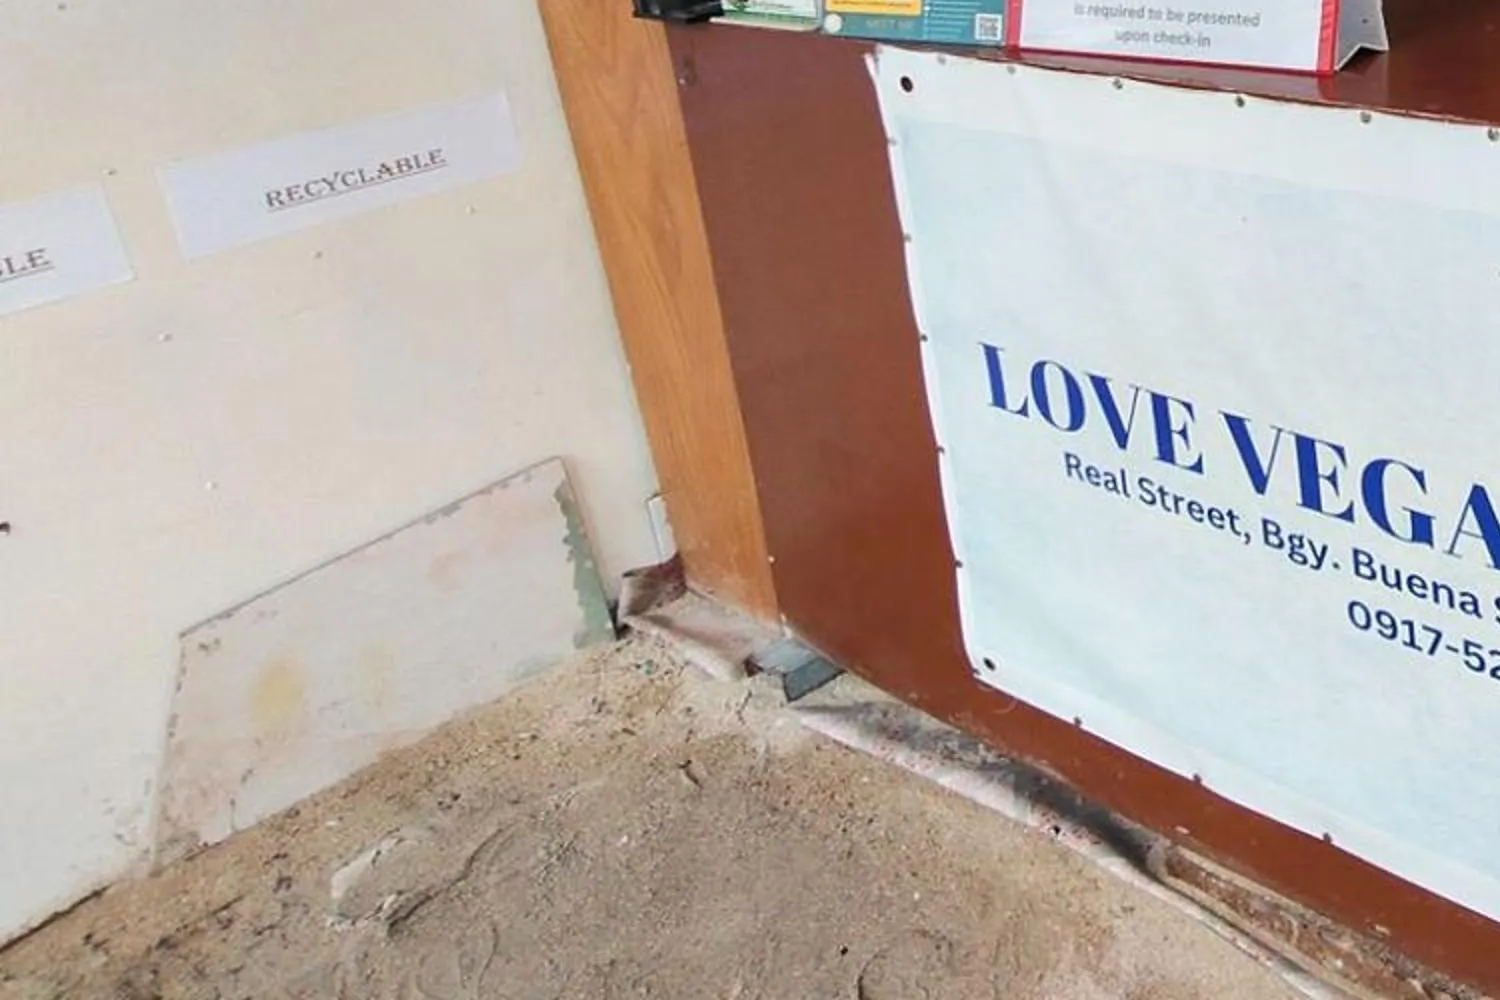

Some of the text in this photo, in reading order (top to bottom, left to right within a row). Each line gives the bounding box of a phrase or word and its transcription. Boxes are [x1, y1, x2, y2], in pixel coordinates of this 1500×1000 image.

[1074, 3, 1261, 29] is required to be presented
[1115, 31, 1211, 47] upon check-in
[264, 148, 448, 210] RECYCLABLE
[0, 247, 52, 277] LE
[978, 341, 1205, 475] LOVE
[1065, 452, 1131, 500] Real
[1137, 476, 1252, 545] Street,
[1262, 518, 1342, 570] Bgy.
[1353, 548, 1481, 618] Buena
